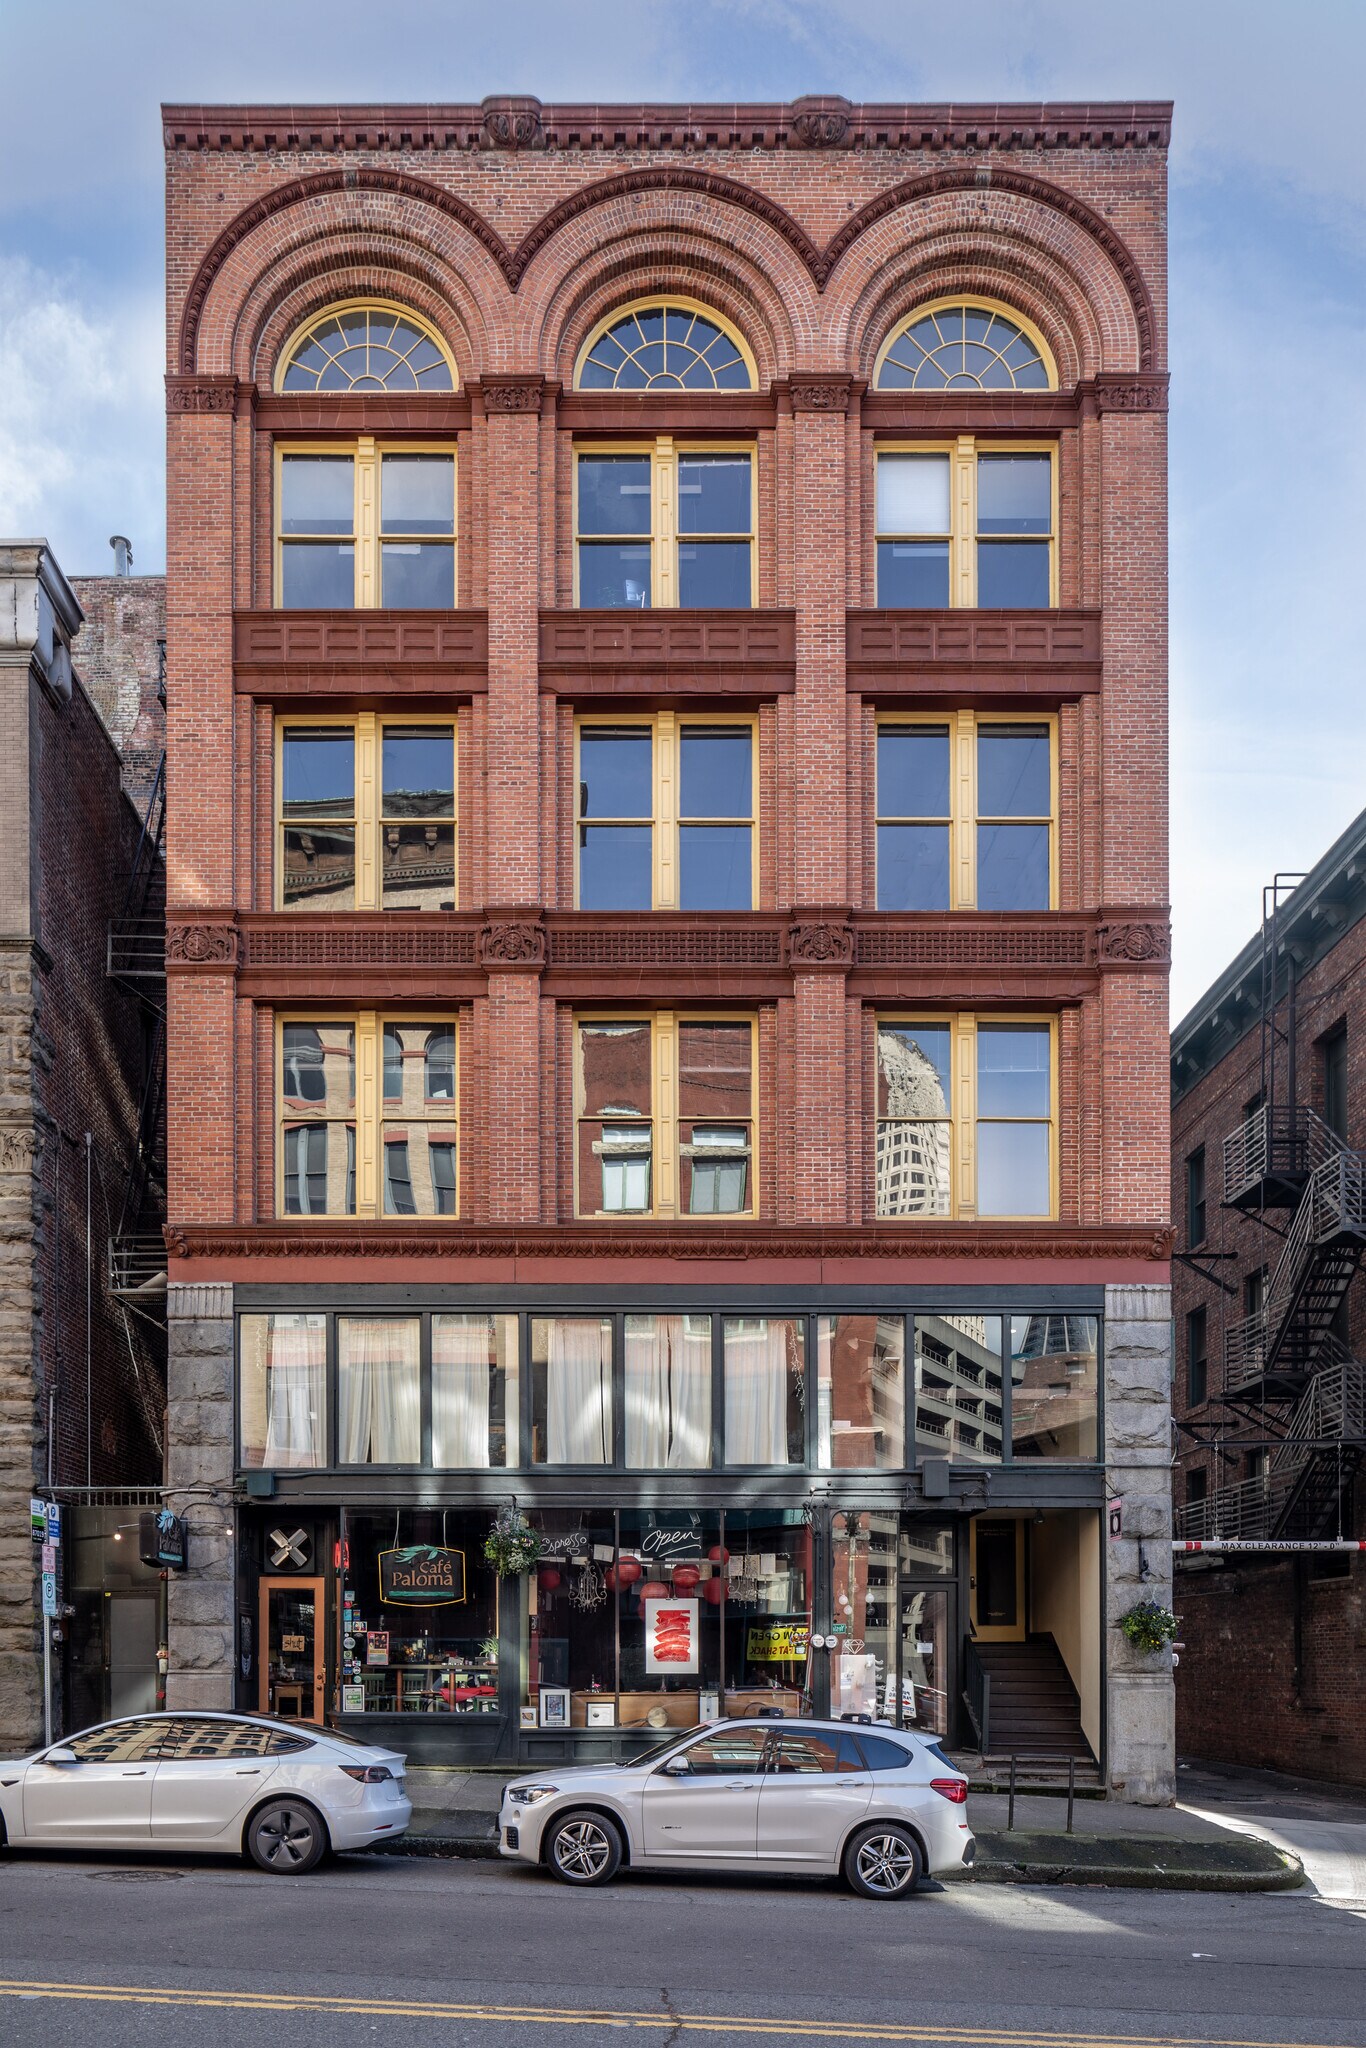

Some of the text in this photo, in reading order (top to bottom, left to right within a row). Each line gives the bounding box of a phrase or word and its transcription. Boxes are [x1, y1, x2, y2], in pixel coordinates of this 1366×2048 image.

[643, 1530, 700, 1553] Open
[1221, 1542, 1242, 1550] MAX
[1245, 1542, 1305, 1550] CLEARANCE
[1308, 1542, 1322, 1550] 12'
[419, 1559, 452, 1574] Café
[392, 1570, 453, 1586] Paloma
[284, 1637, 303, 1651] shut
